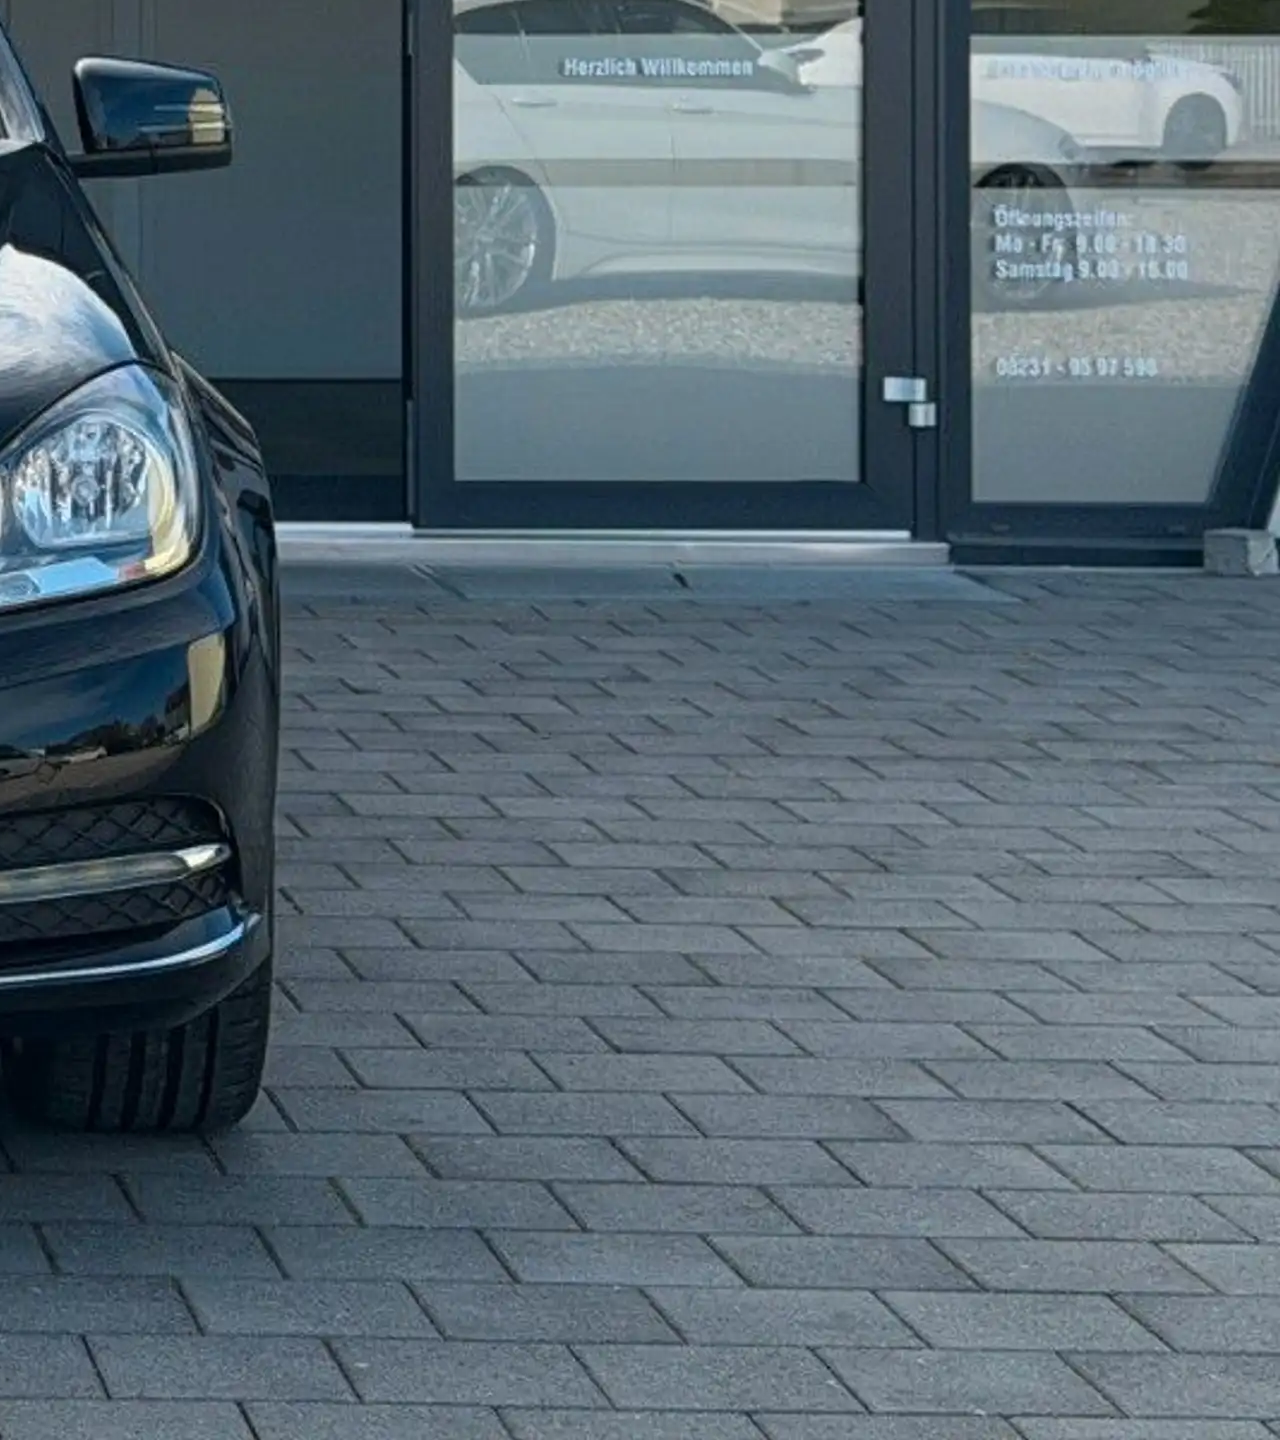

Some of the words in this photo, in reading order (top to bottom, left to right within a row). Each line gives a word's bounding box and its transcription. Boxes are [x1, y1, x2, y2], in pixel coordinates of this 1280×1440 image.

[563, 57, 638, 77] Herzlich
[640, 57, 755, 77] Willkommen
[994, 258, 1074, 282] Samstag
